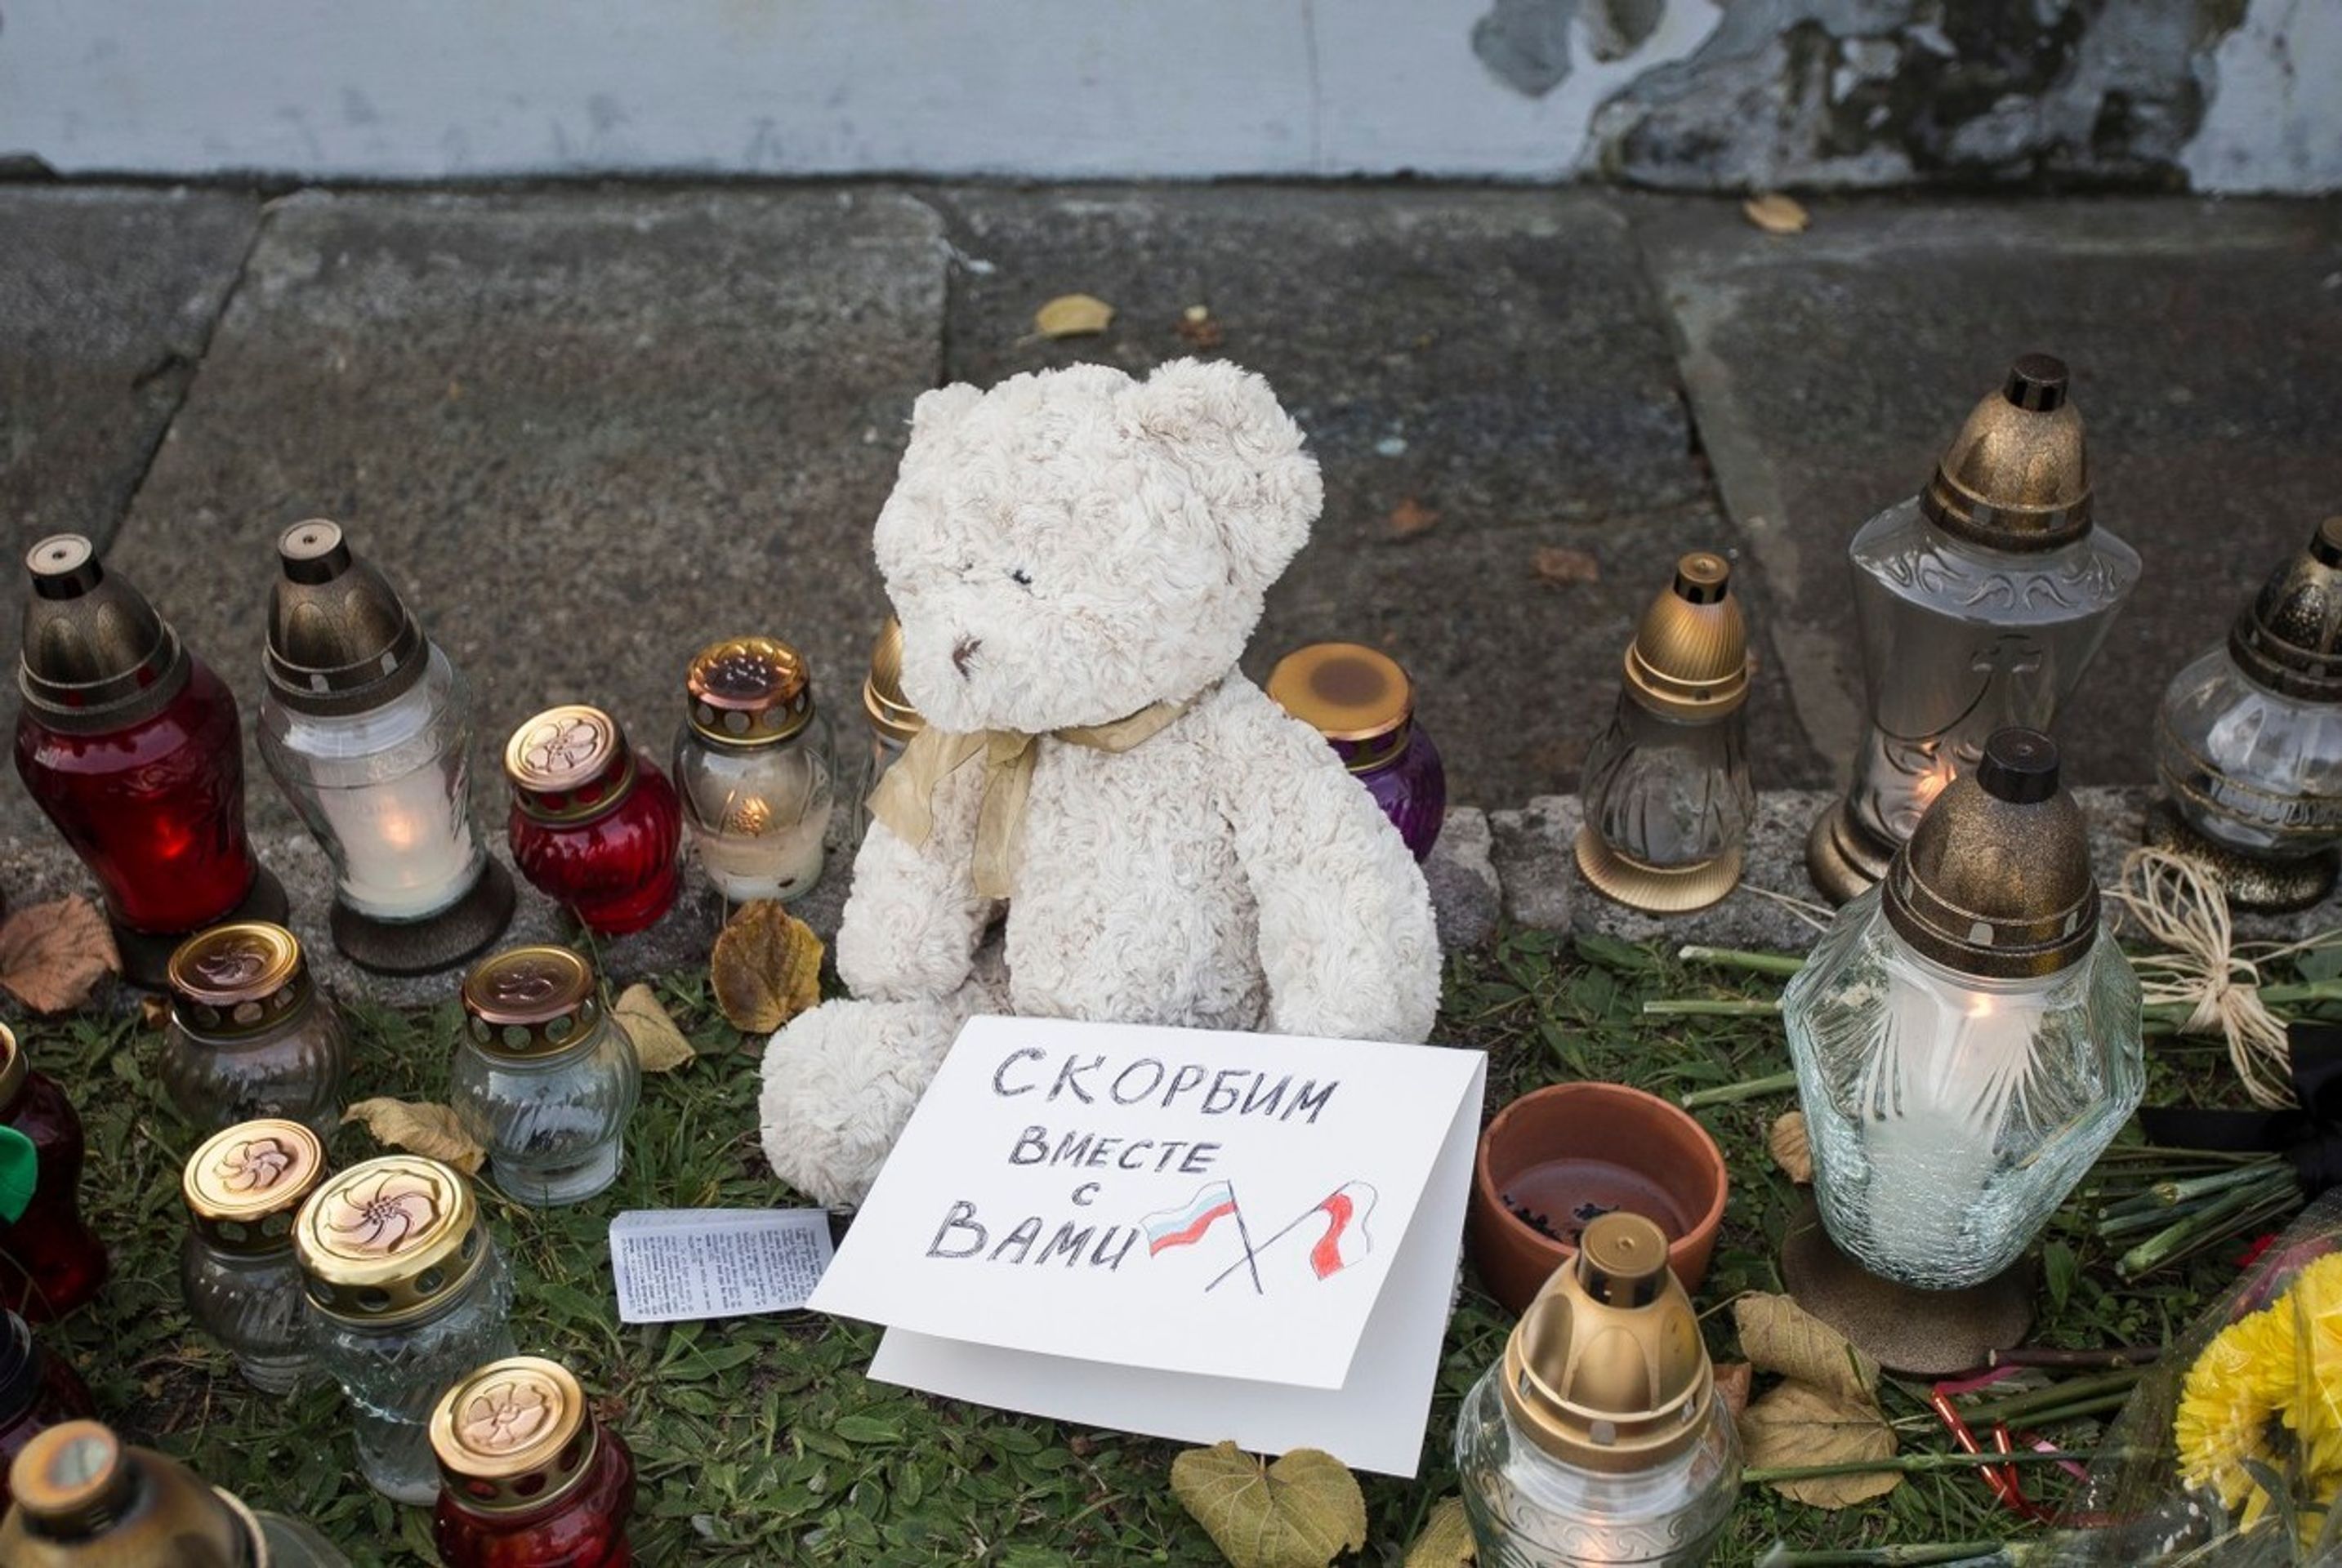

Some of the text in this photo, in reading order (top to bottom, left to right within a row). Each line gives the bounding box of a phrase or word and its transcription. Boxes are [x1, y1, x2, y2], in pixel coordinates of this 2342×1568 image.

[992, 1047, 1340, 1125] СКОРБИМ
[1007, 1125, 1223, 1174] ВМЕСТЕ
[925, 1200, 1140, 1272] ВАМИ
